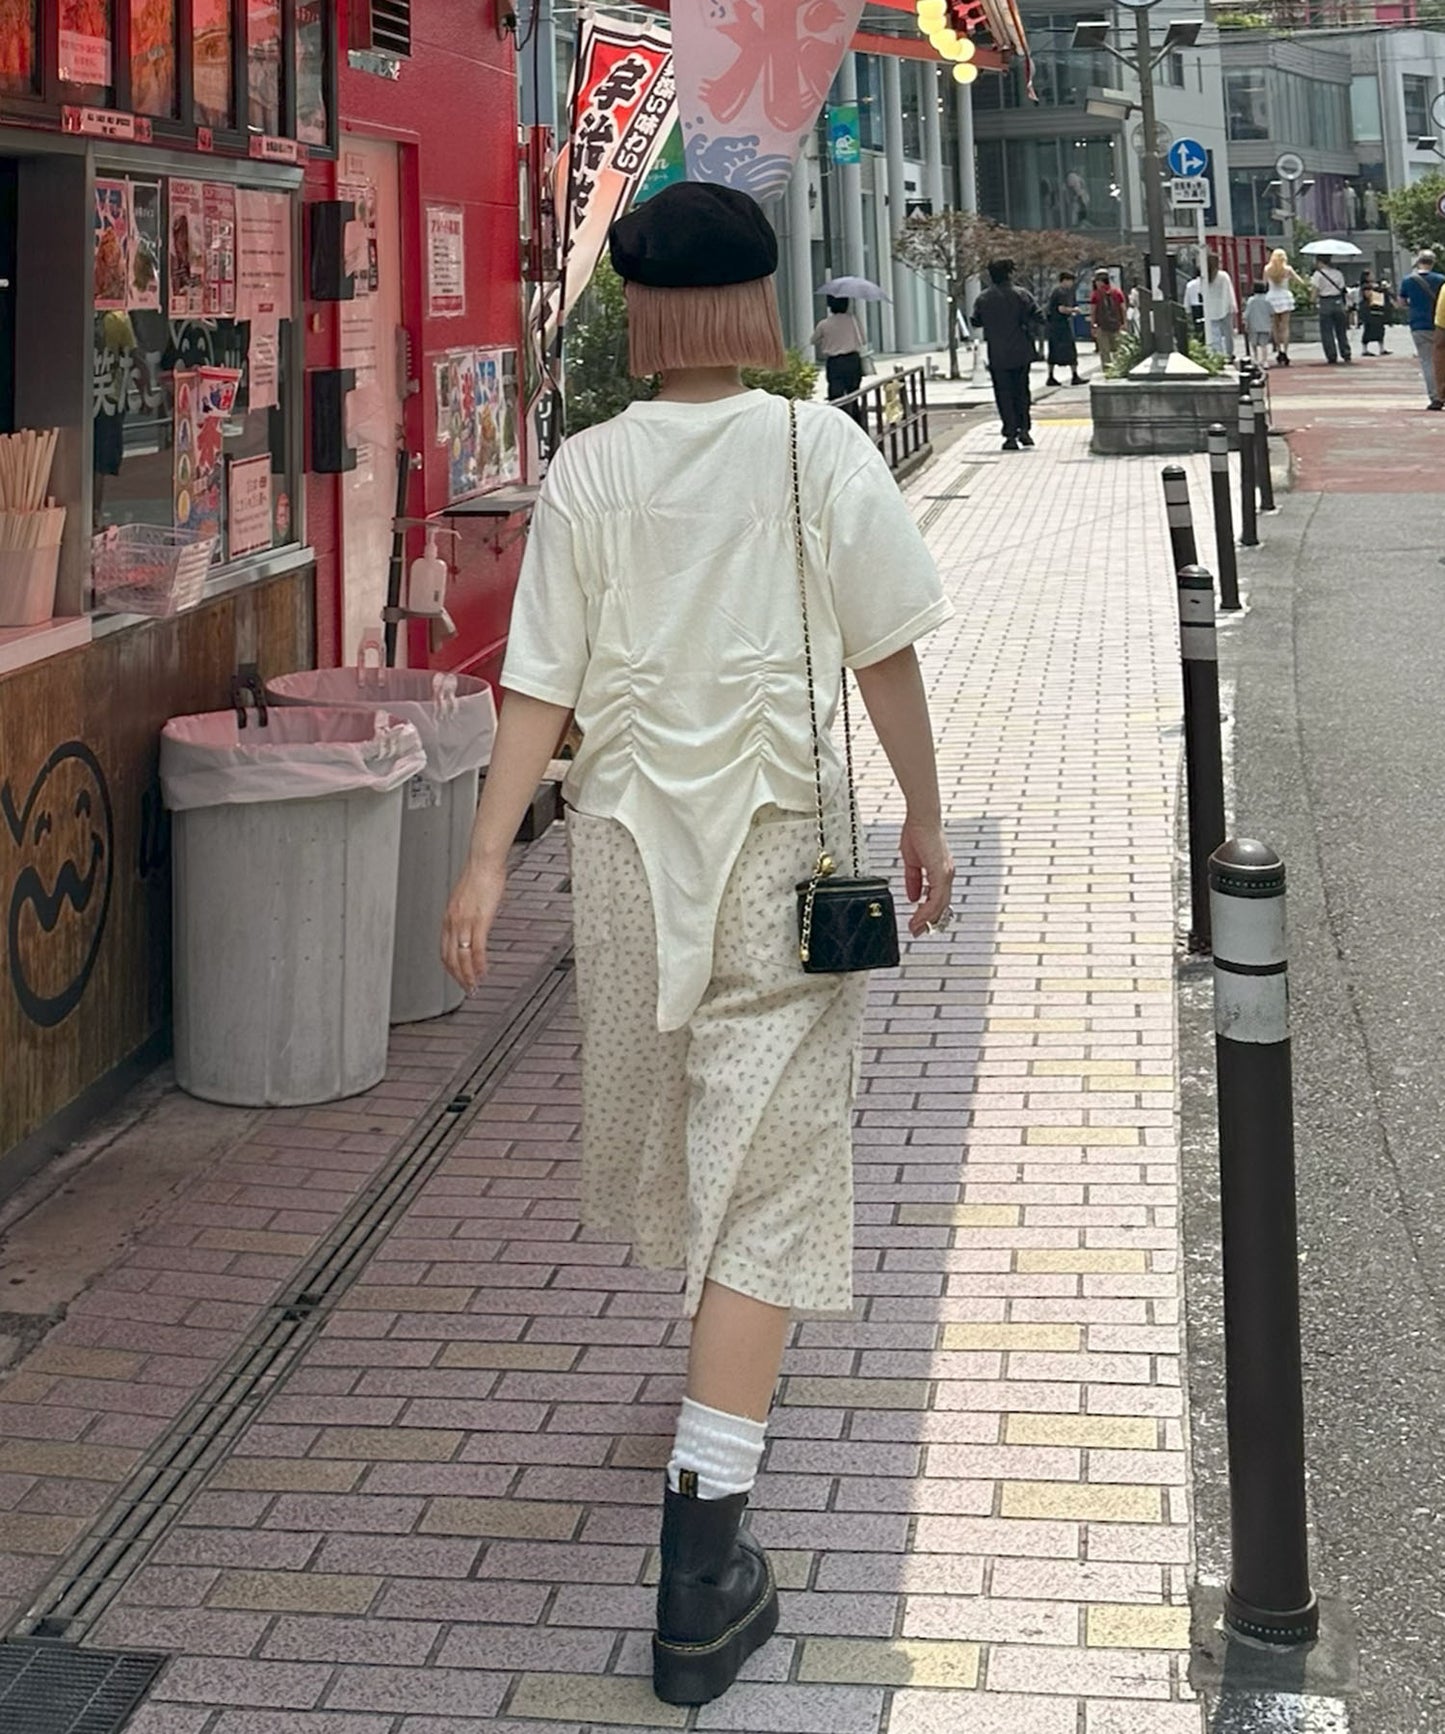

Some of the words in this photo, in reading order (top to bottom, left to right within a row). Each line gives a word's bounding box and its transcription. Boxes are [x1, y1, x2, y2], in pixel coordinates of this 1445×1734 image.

[616, 60, 677, 170] 深い味わい
